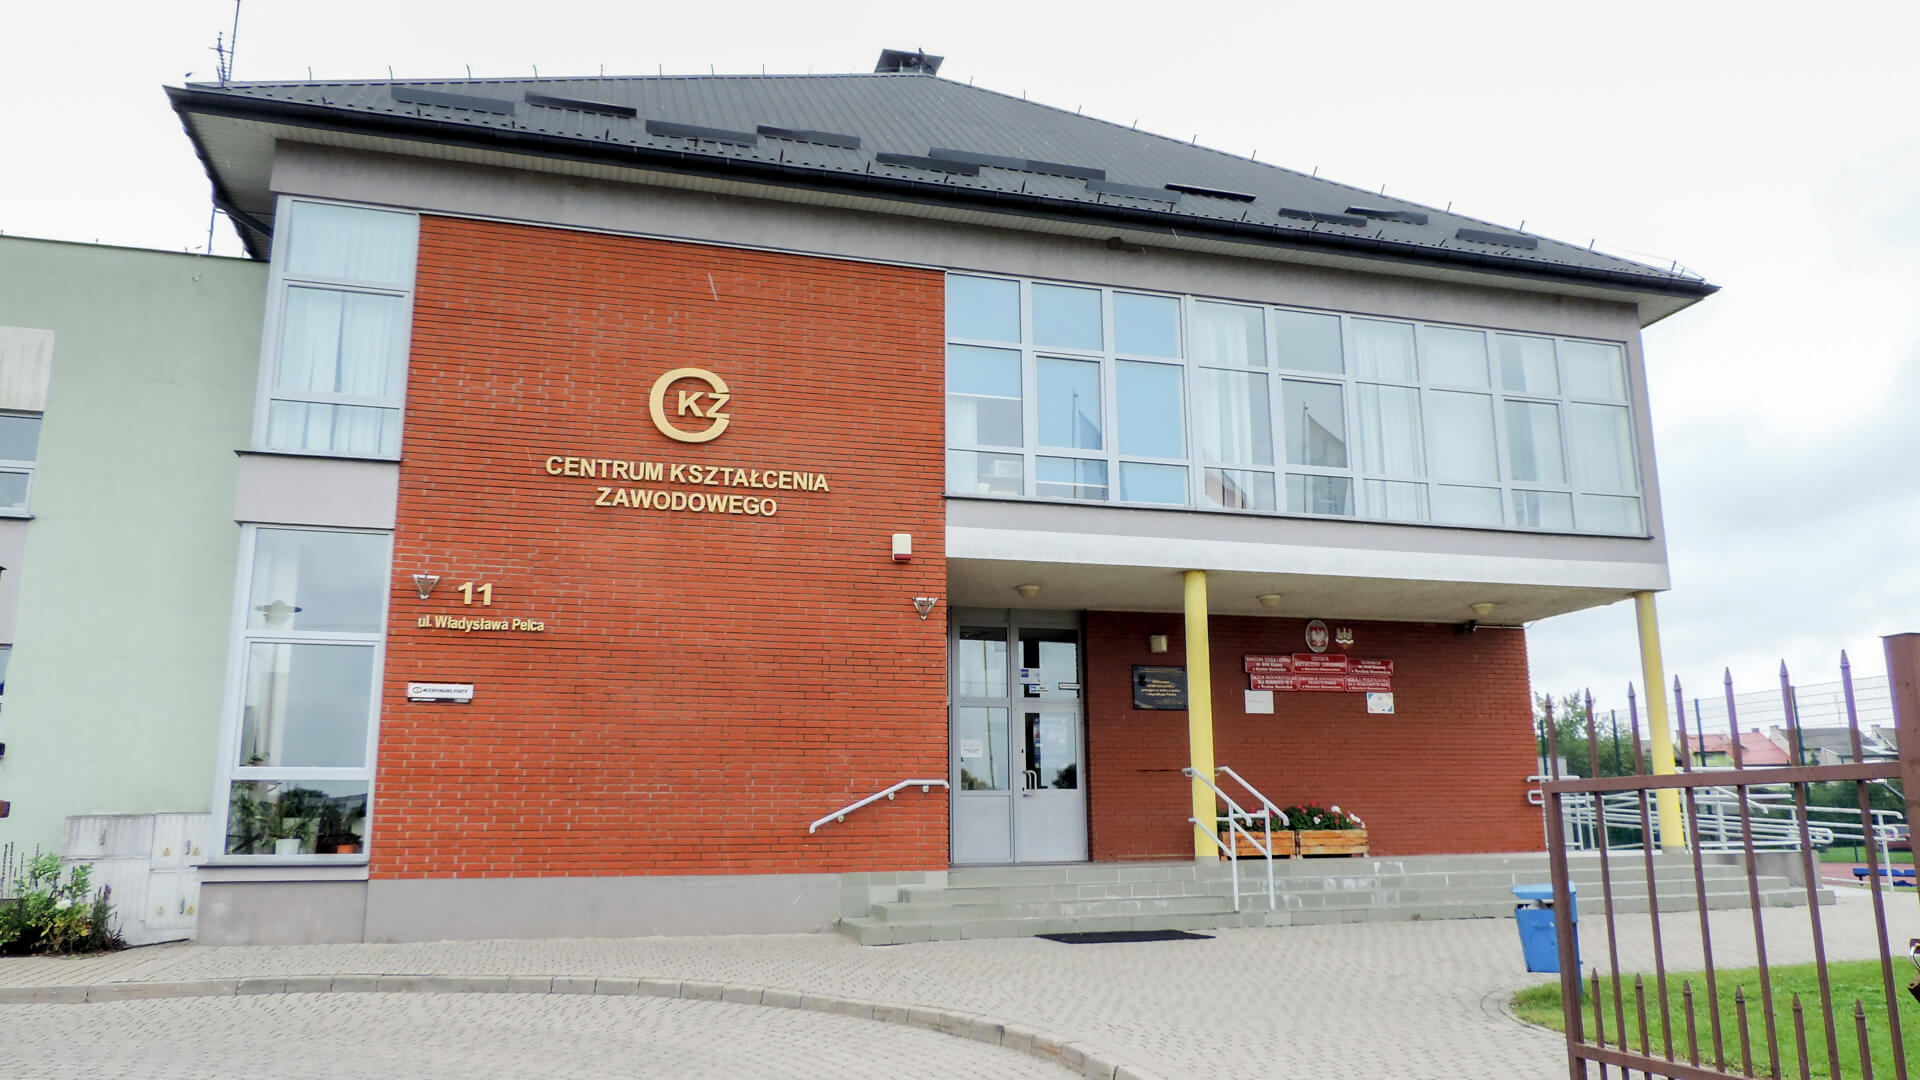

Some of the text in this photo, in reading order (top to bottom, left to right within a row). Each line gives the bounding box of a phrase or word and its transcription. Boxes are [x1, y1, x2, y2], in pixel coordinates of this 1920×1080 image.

[545, 455, 829, 492] CENTRUM KSZTAŁCENIA
[595, 486, 777, 516] ZAWODOWEGO
[457, 581, 493, 606] 11
[434, 615, 509, 633] Władysława
[511, 618, 545, 632] Pelca
